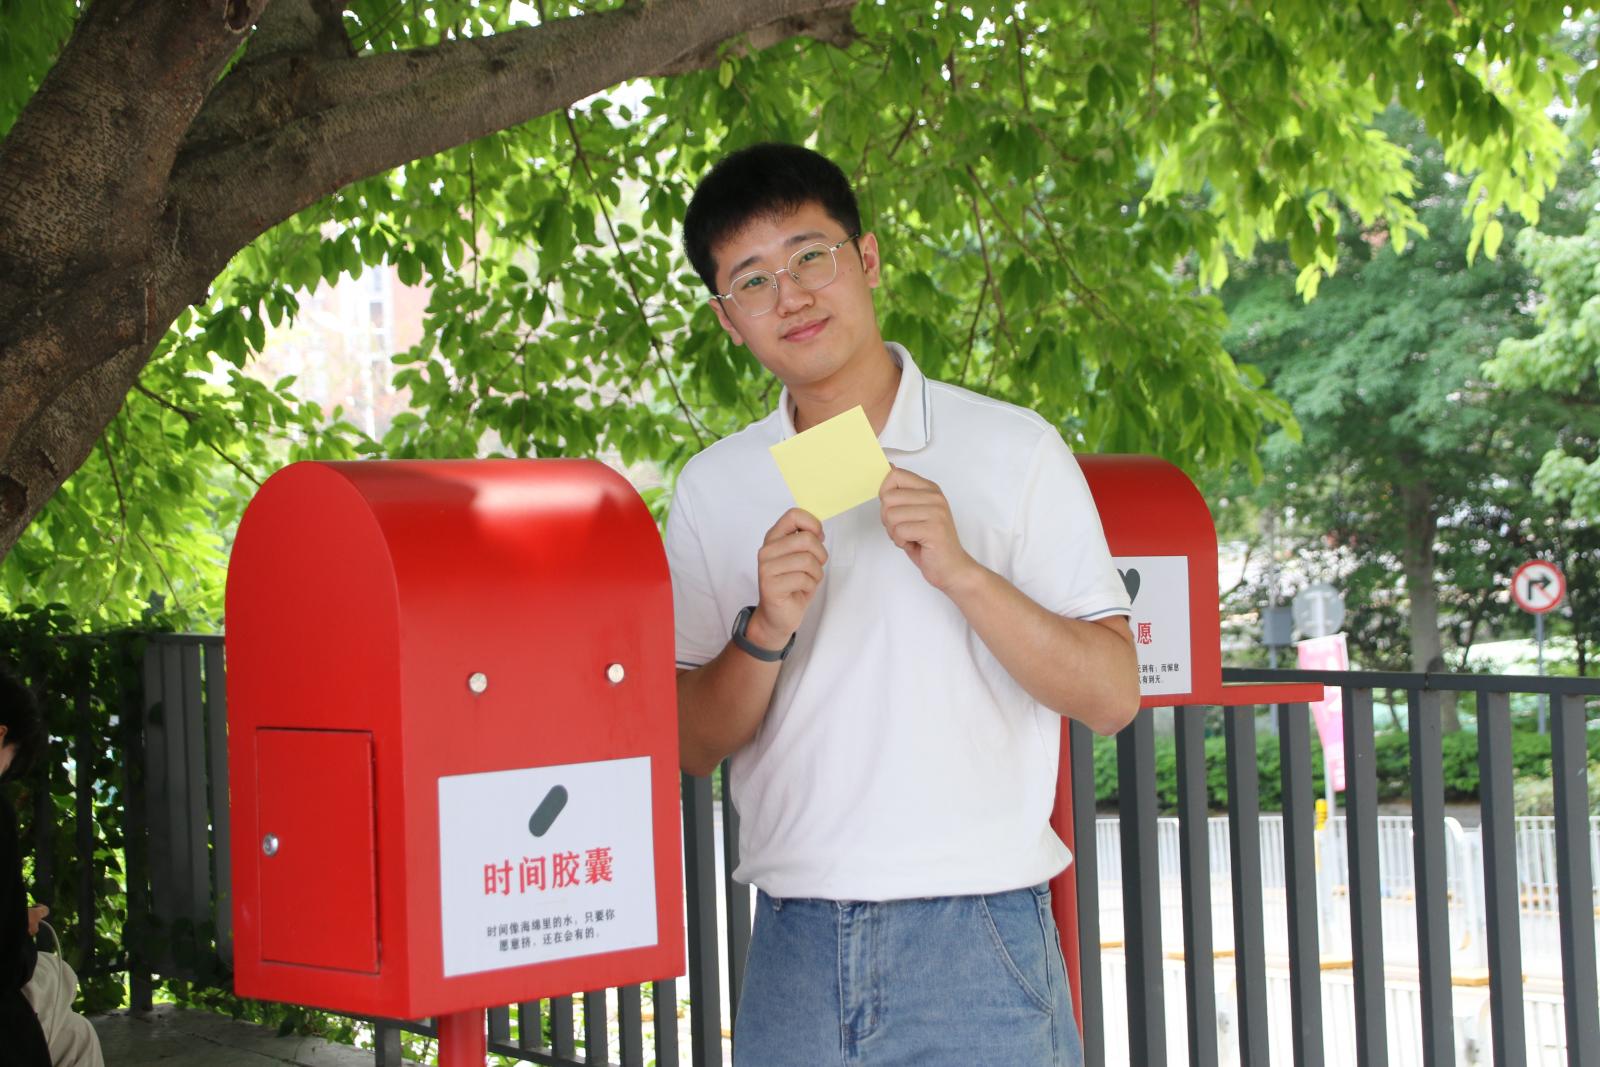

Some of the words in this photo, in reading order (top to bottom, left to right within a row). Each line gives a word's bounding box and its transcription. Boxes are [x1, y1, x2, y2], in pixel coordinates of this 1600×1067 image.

[1137, 622, 1152, 645] 愿
[484, 846, 613, 896] 时间胶囊
